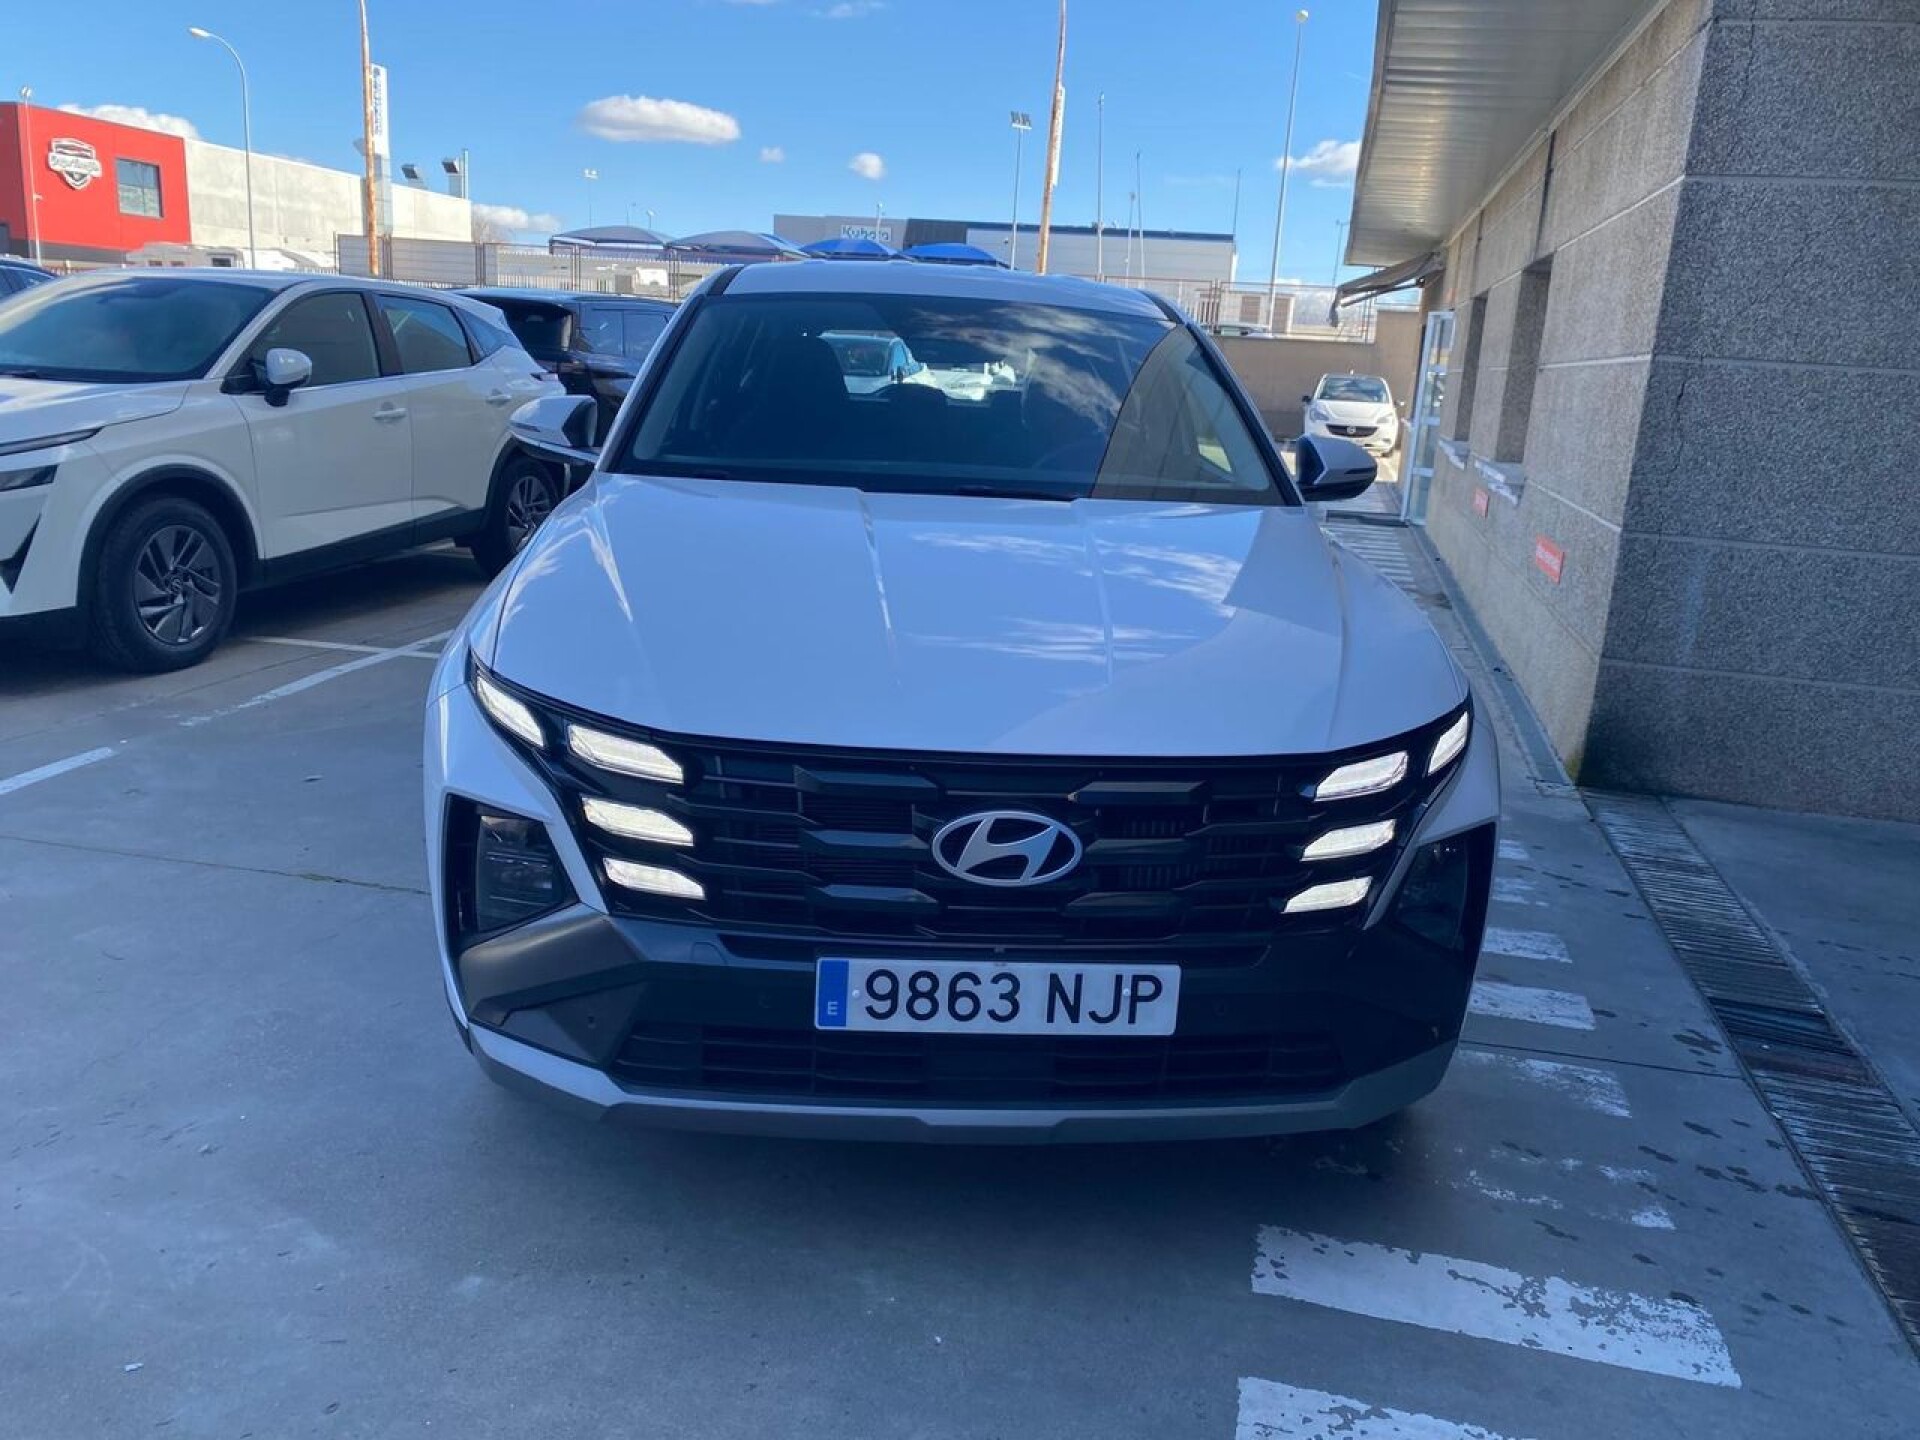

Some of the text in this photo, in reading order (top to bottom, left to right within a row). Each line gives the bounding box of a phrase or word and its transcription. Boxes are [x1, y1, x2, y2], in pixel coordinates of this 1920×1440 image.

[826, 1001, 839, 1016] E
[865, 969, 1162, 1024] 9863 NJP
